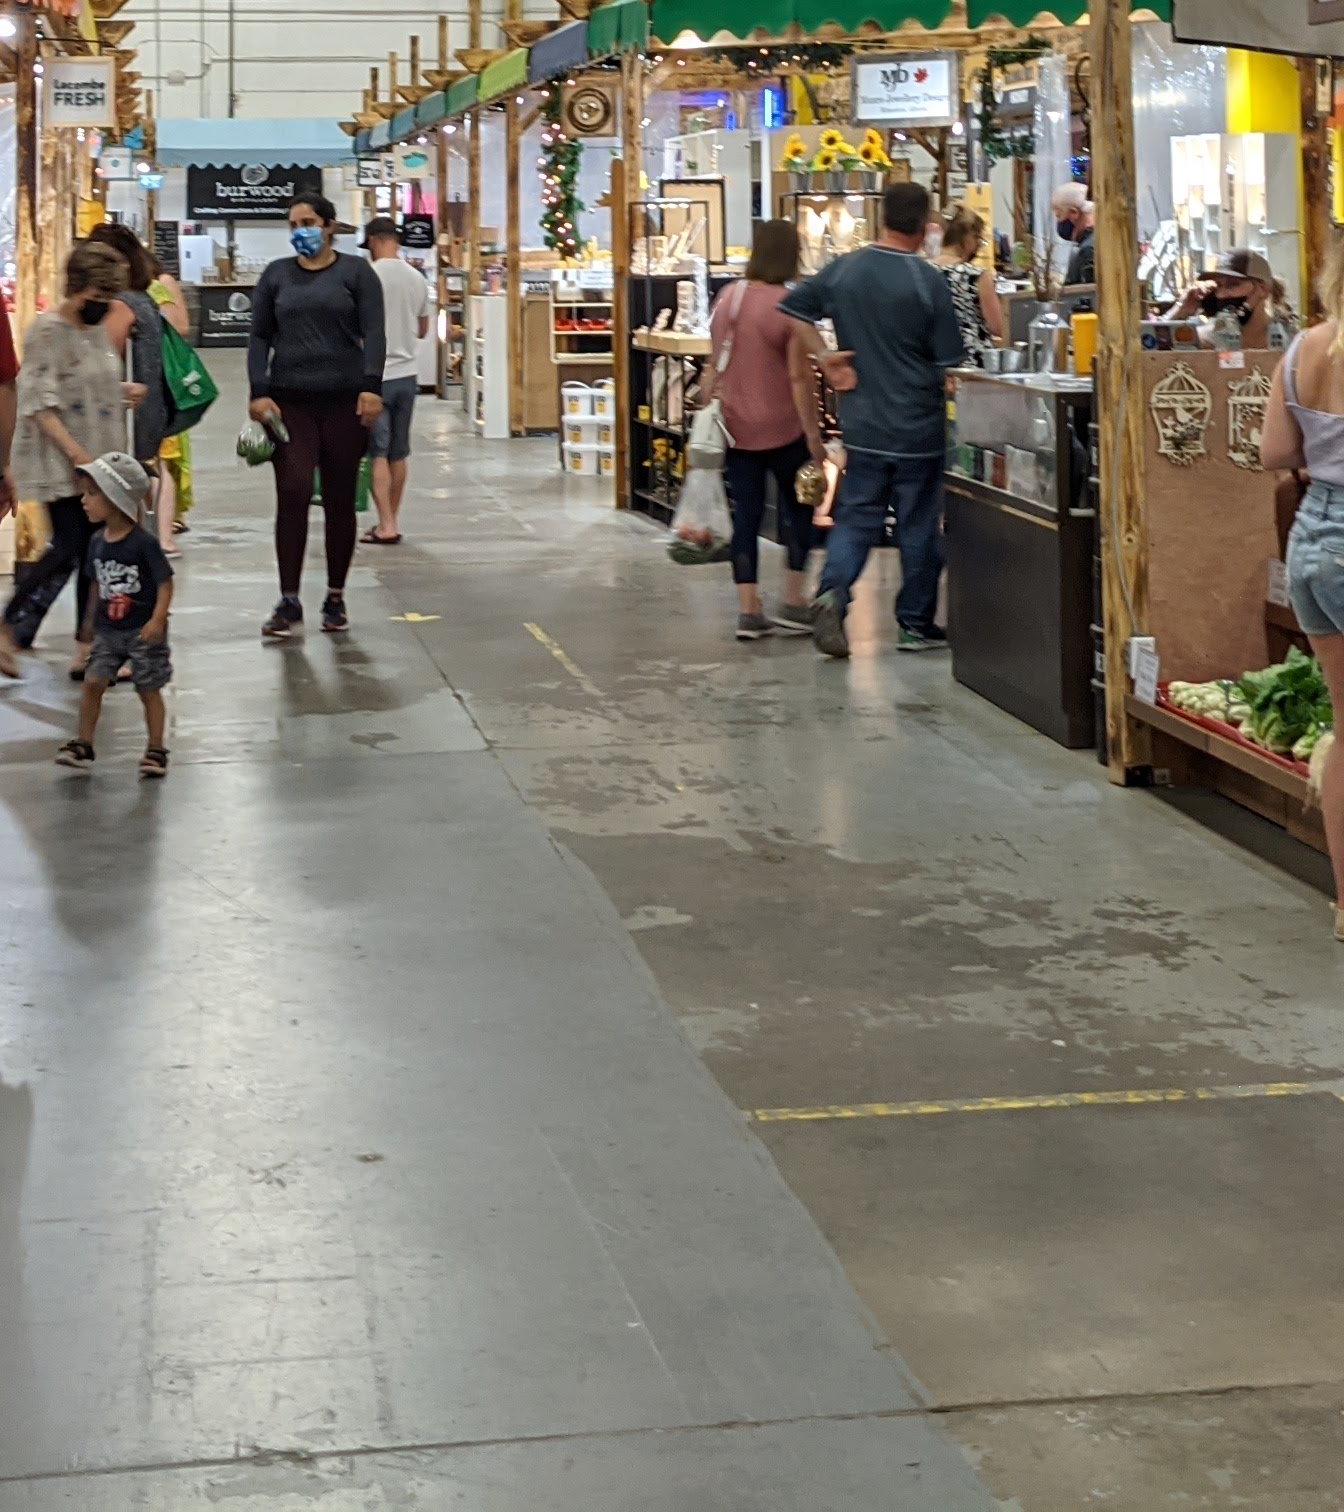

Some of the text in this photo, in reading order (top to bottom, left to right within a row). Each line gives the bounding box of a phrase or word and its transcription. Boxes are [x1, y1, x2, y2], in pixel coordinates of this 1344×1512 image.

[53, 92, 106, 106] FRESH
[215, 181, 295, 197] burwood
[209, 309, 252, 322] burwo
